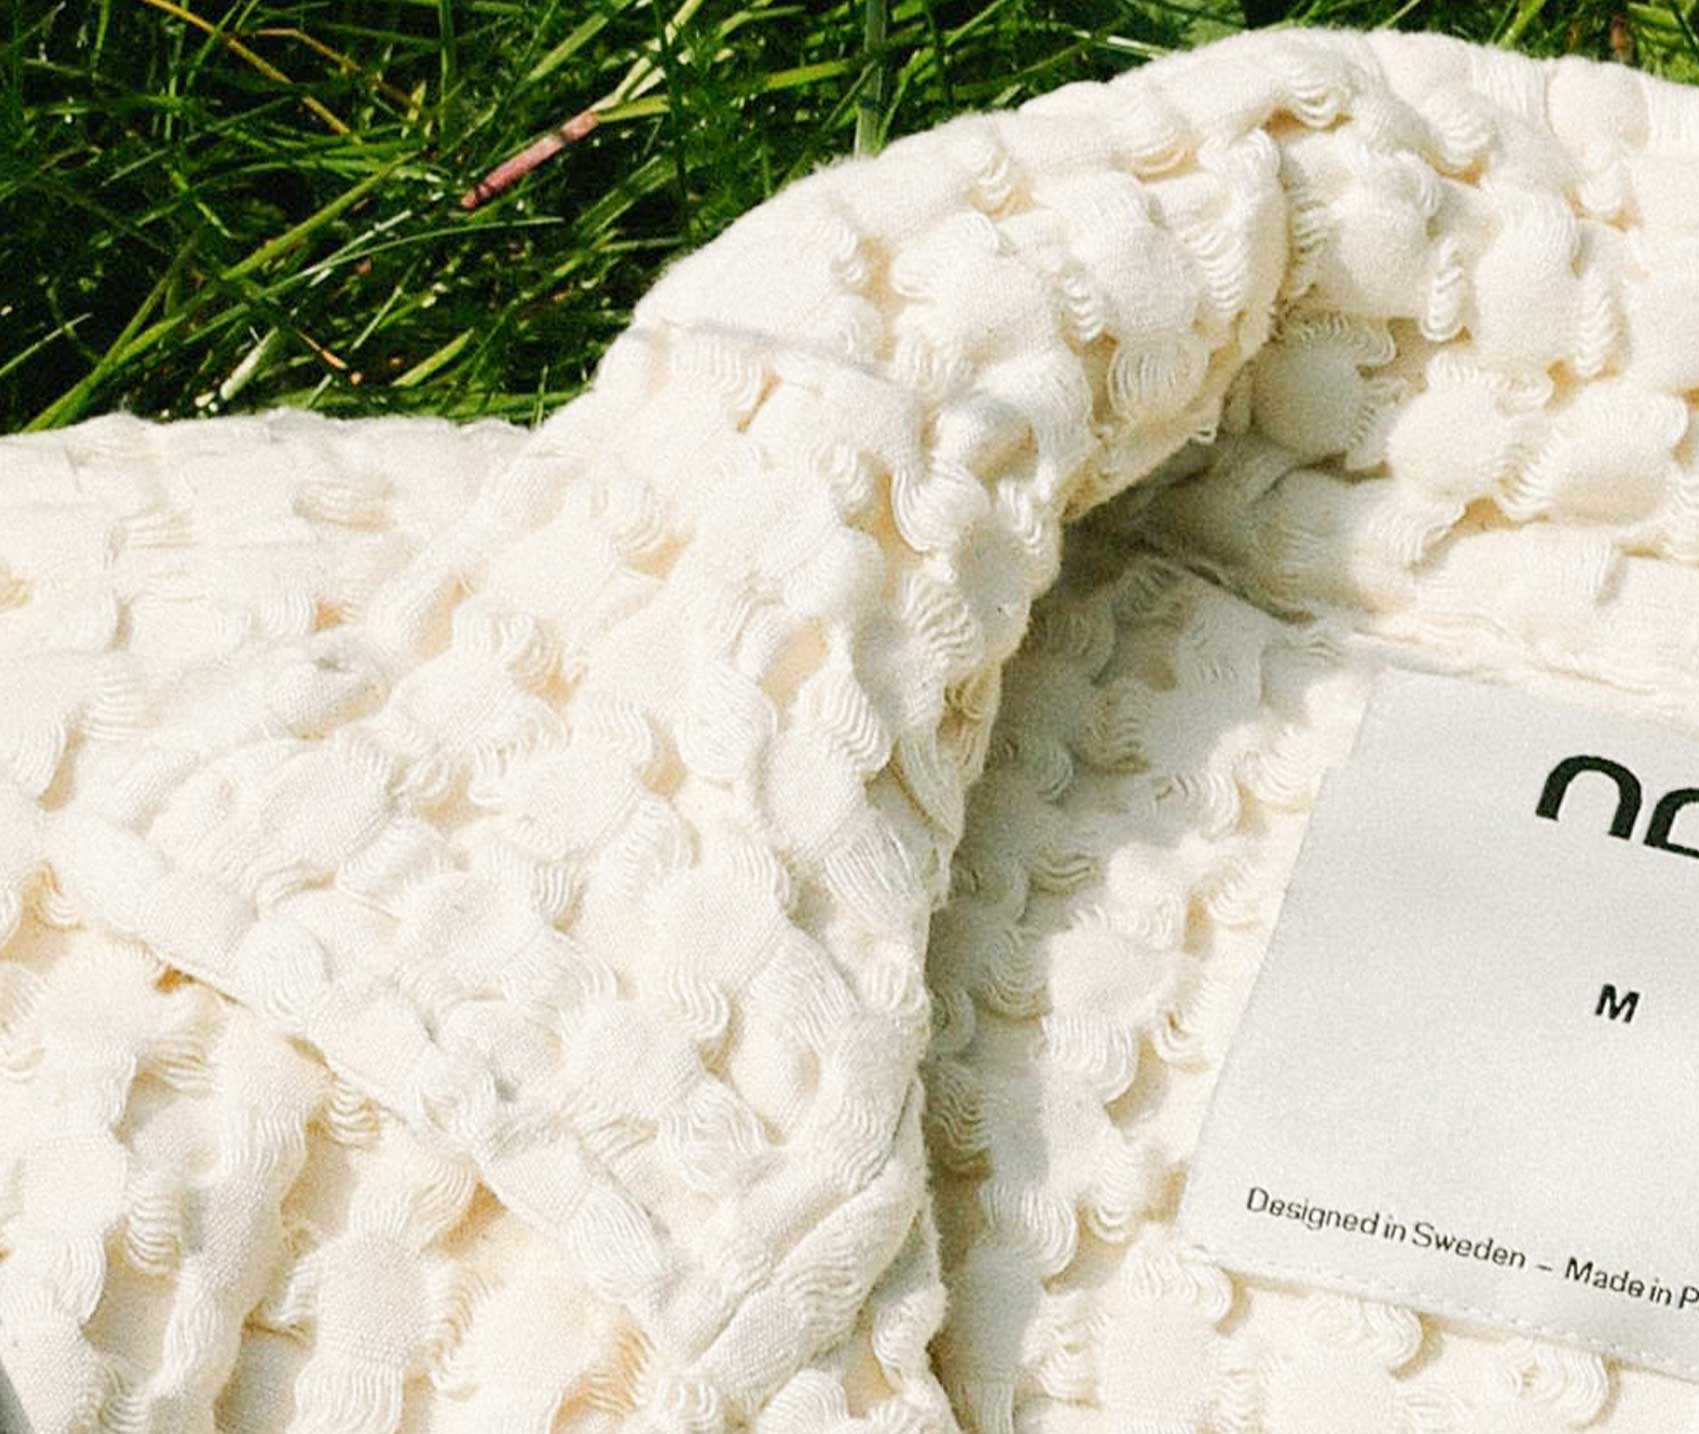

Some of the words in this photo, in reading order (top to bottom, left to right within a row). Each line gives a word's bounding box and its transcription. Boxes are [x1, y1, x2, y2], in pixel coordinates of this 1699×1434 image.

[1594, 983, 1641, 1024] M
[1245, 1186, 1381, 1236] Designed
[1382, 1213, 1407, 1243] in
[1411, 1221, 1527, 1269] Sweden
[1564, 1256, 1645, 1298] Made
[1648, 1276, 1673, 1306] in
